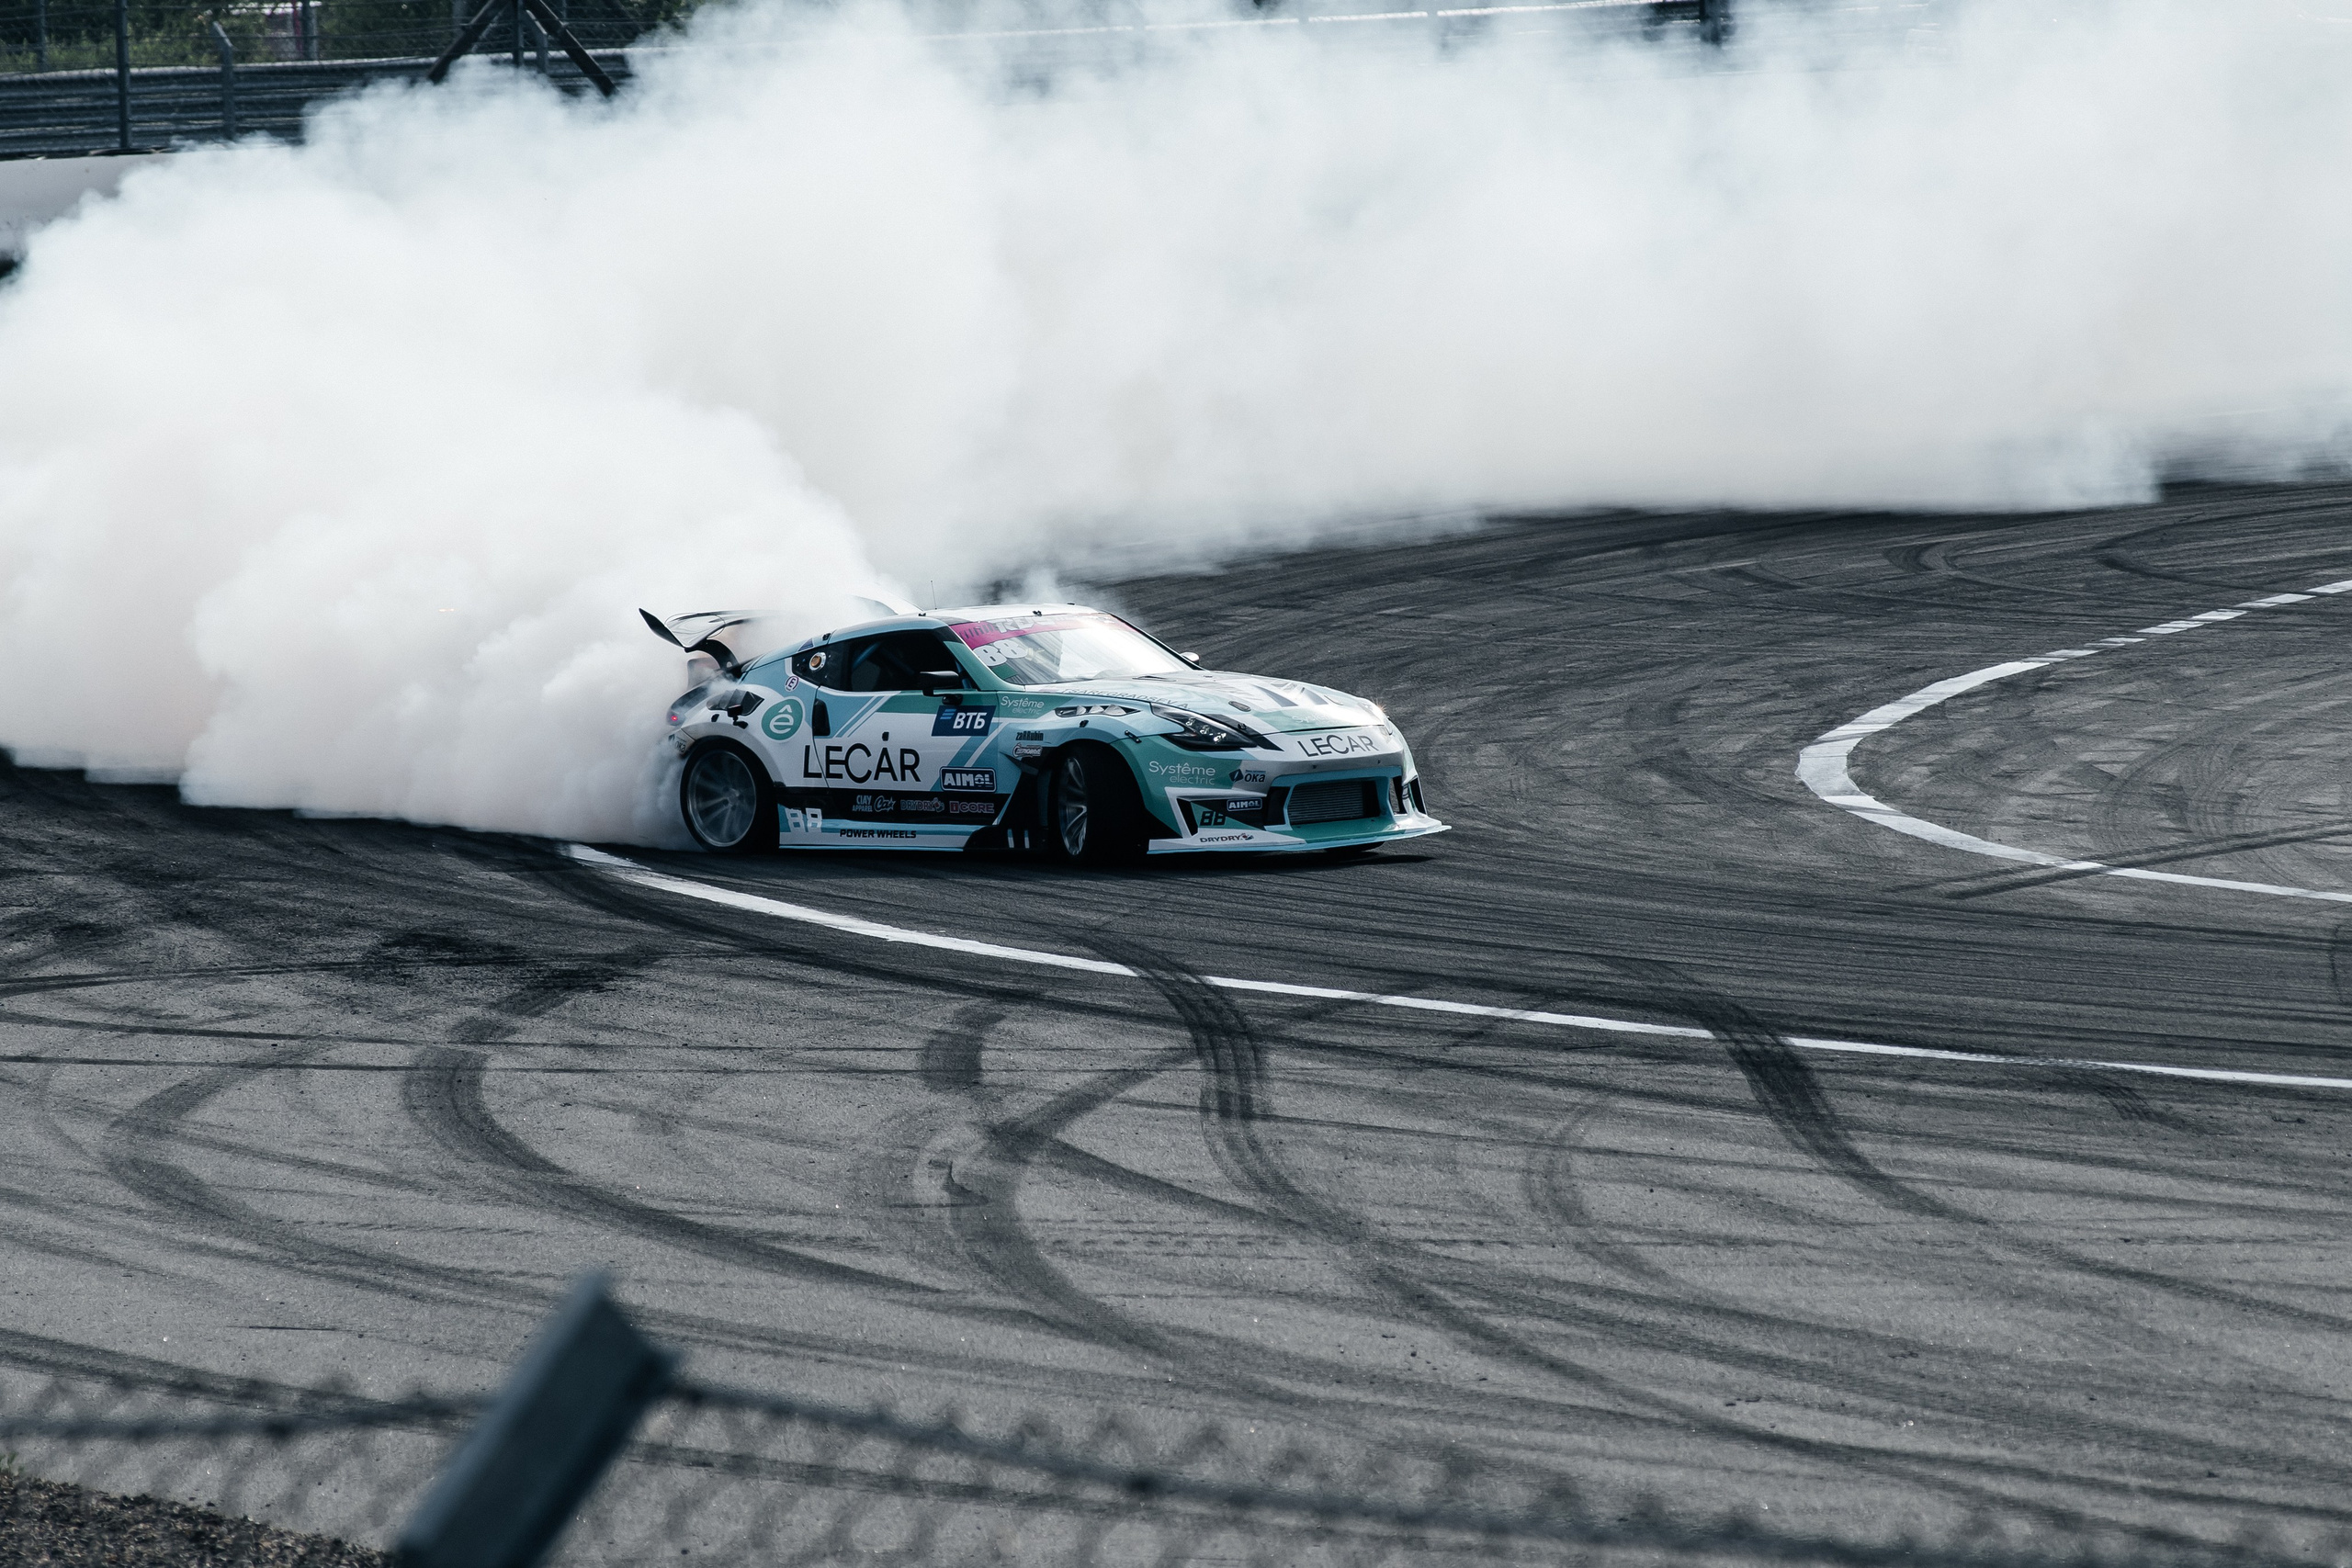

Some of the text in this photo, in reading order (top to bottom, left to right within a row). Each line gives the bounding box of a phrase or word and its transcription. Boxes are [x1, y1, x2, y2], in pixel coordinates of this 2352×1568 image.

[972, 638, 1029, 667] 88
[1000, 695, 1045, 709] Système
[1012, 707, 1043, 716] electric
[953, 712, 988, 729] ВТБ
[1296, 734, 1378, 758] LECAR
[803, 742, 922, 783] LECAR
[1148, 760, 1216, 777] Système
[944, 772, 993, 787] AIMOL
[1170, 773, 1216, 786] electric
[852, 805, 873, 813] APPAREL
[1228, 800, 1261, 809] AIMOL
[784, 807, 823, 833] 88
[1199, 810, 1227, 827] 88
[839, 829, 917, 839] POWER WHEELS
[1199, 834, 1241, 843] DRYDRY
